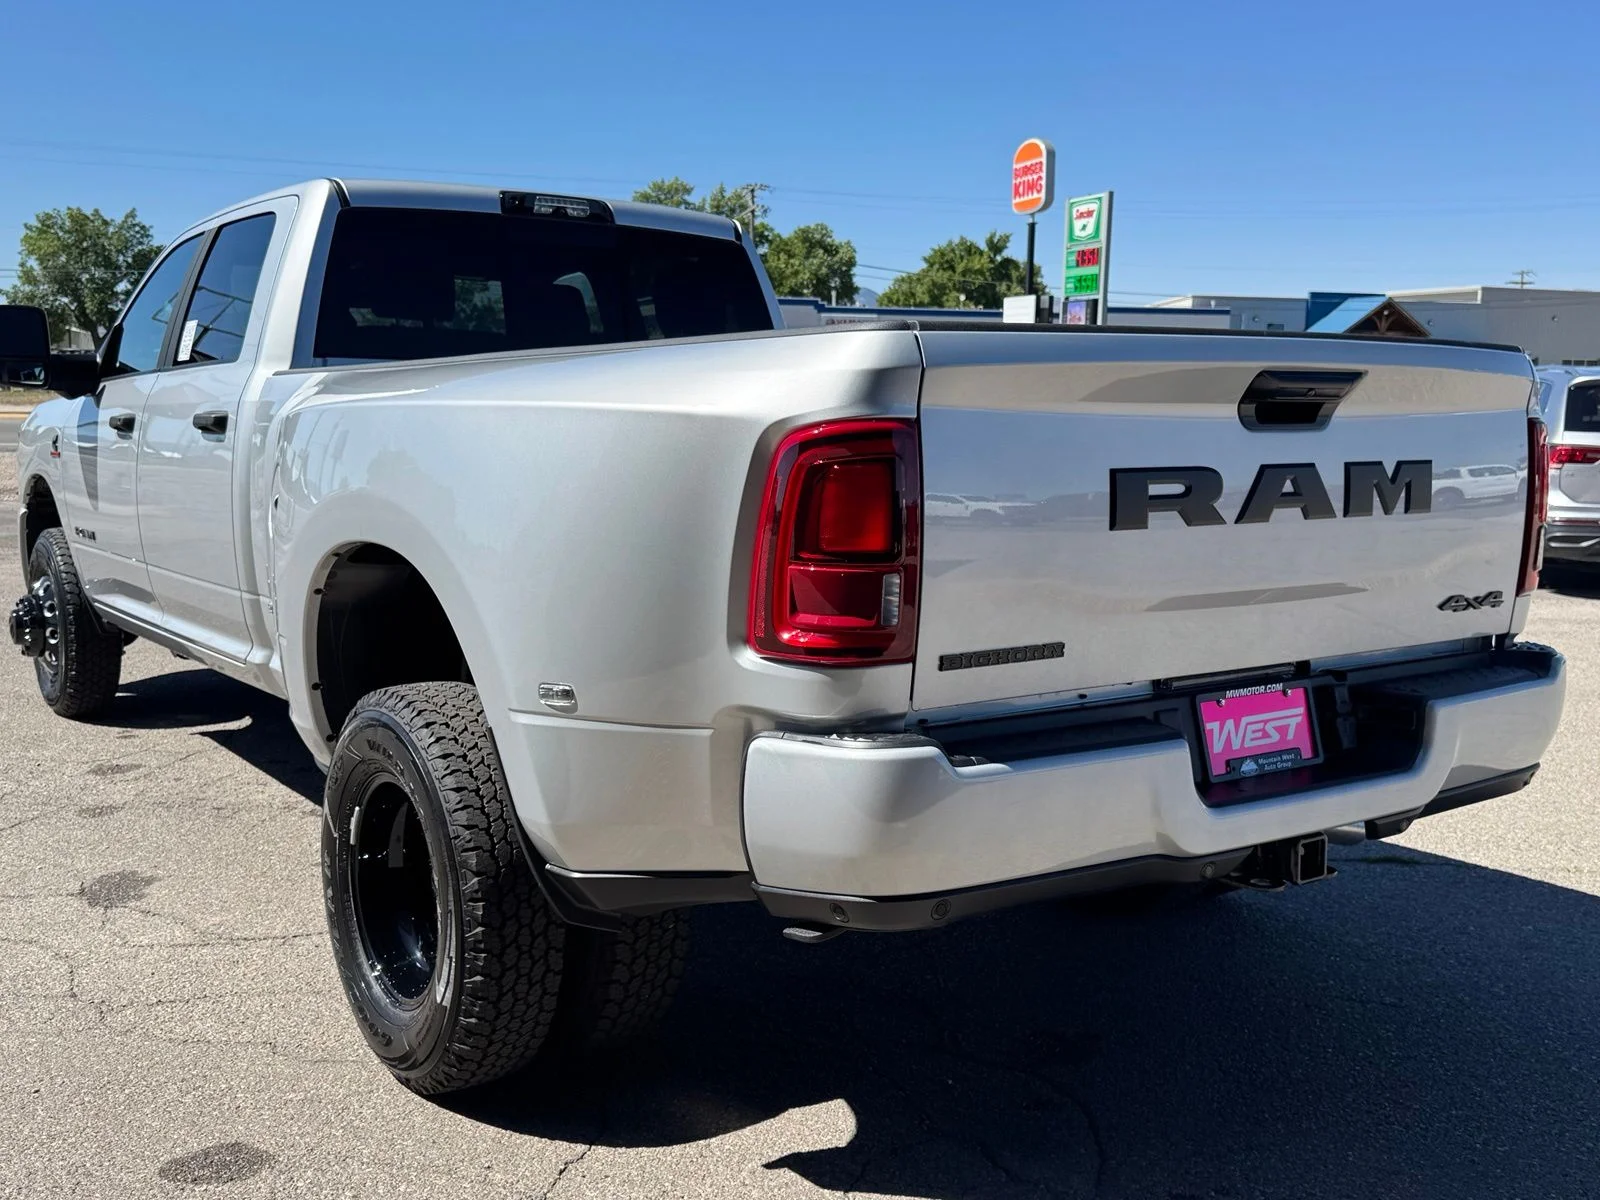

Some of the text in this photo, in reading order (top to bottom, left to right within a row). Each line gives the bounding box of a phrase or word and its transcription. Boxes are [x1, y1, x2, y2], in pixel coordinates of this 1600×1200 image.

[1014, 161, 1043, 179] BURGER
[1014, 175, 1043, 199] KING
[1109, 460, 1432, 531] RAM
[938, 641, 1065, 671] BIGHORN
[1225, 682, 1283, 699] MWMOTOR.COM
[1206, 707, 1304, 753] WEST
[1258, 753, 1295, 765] Mountain West
[1264, 761, 1291, 771] Auto Group
